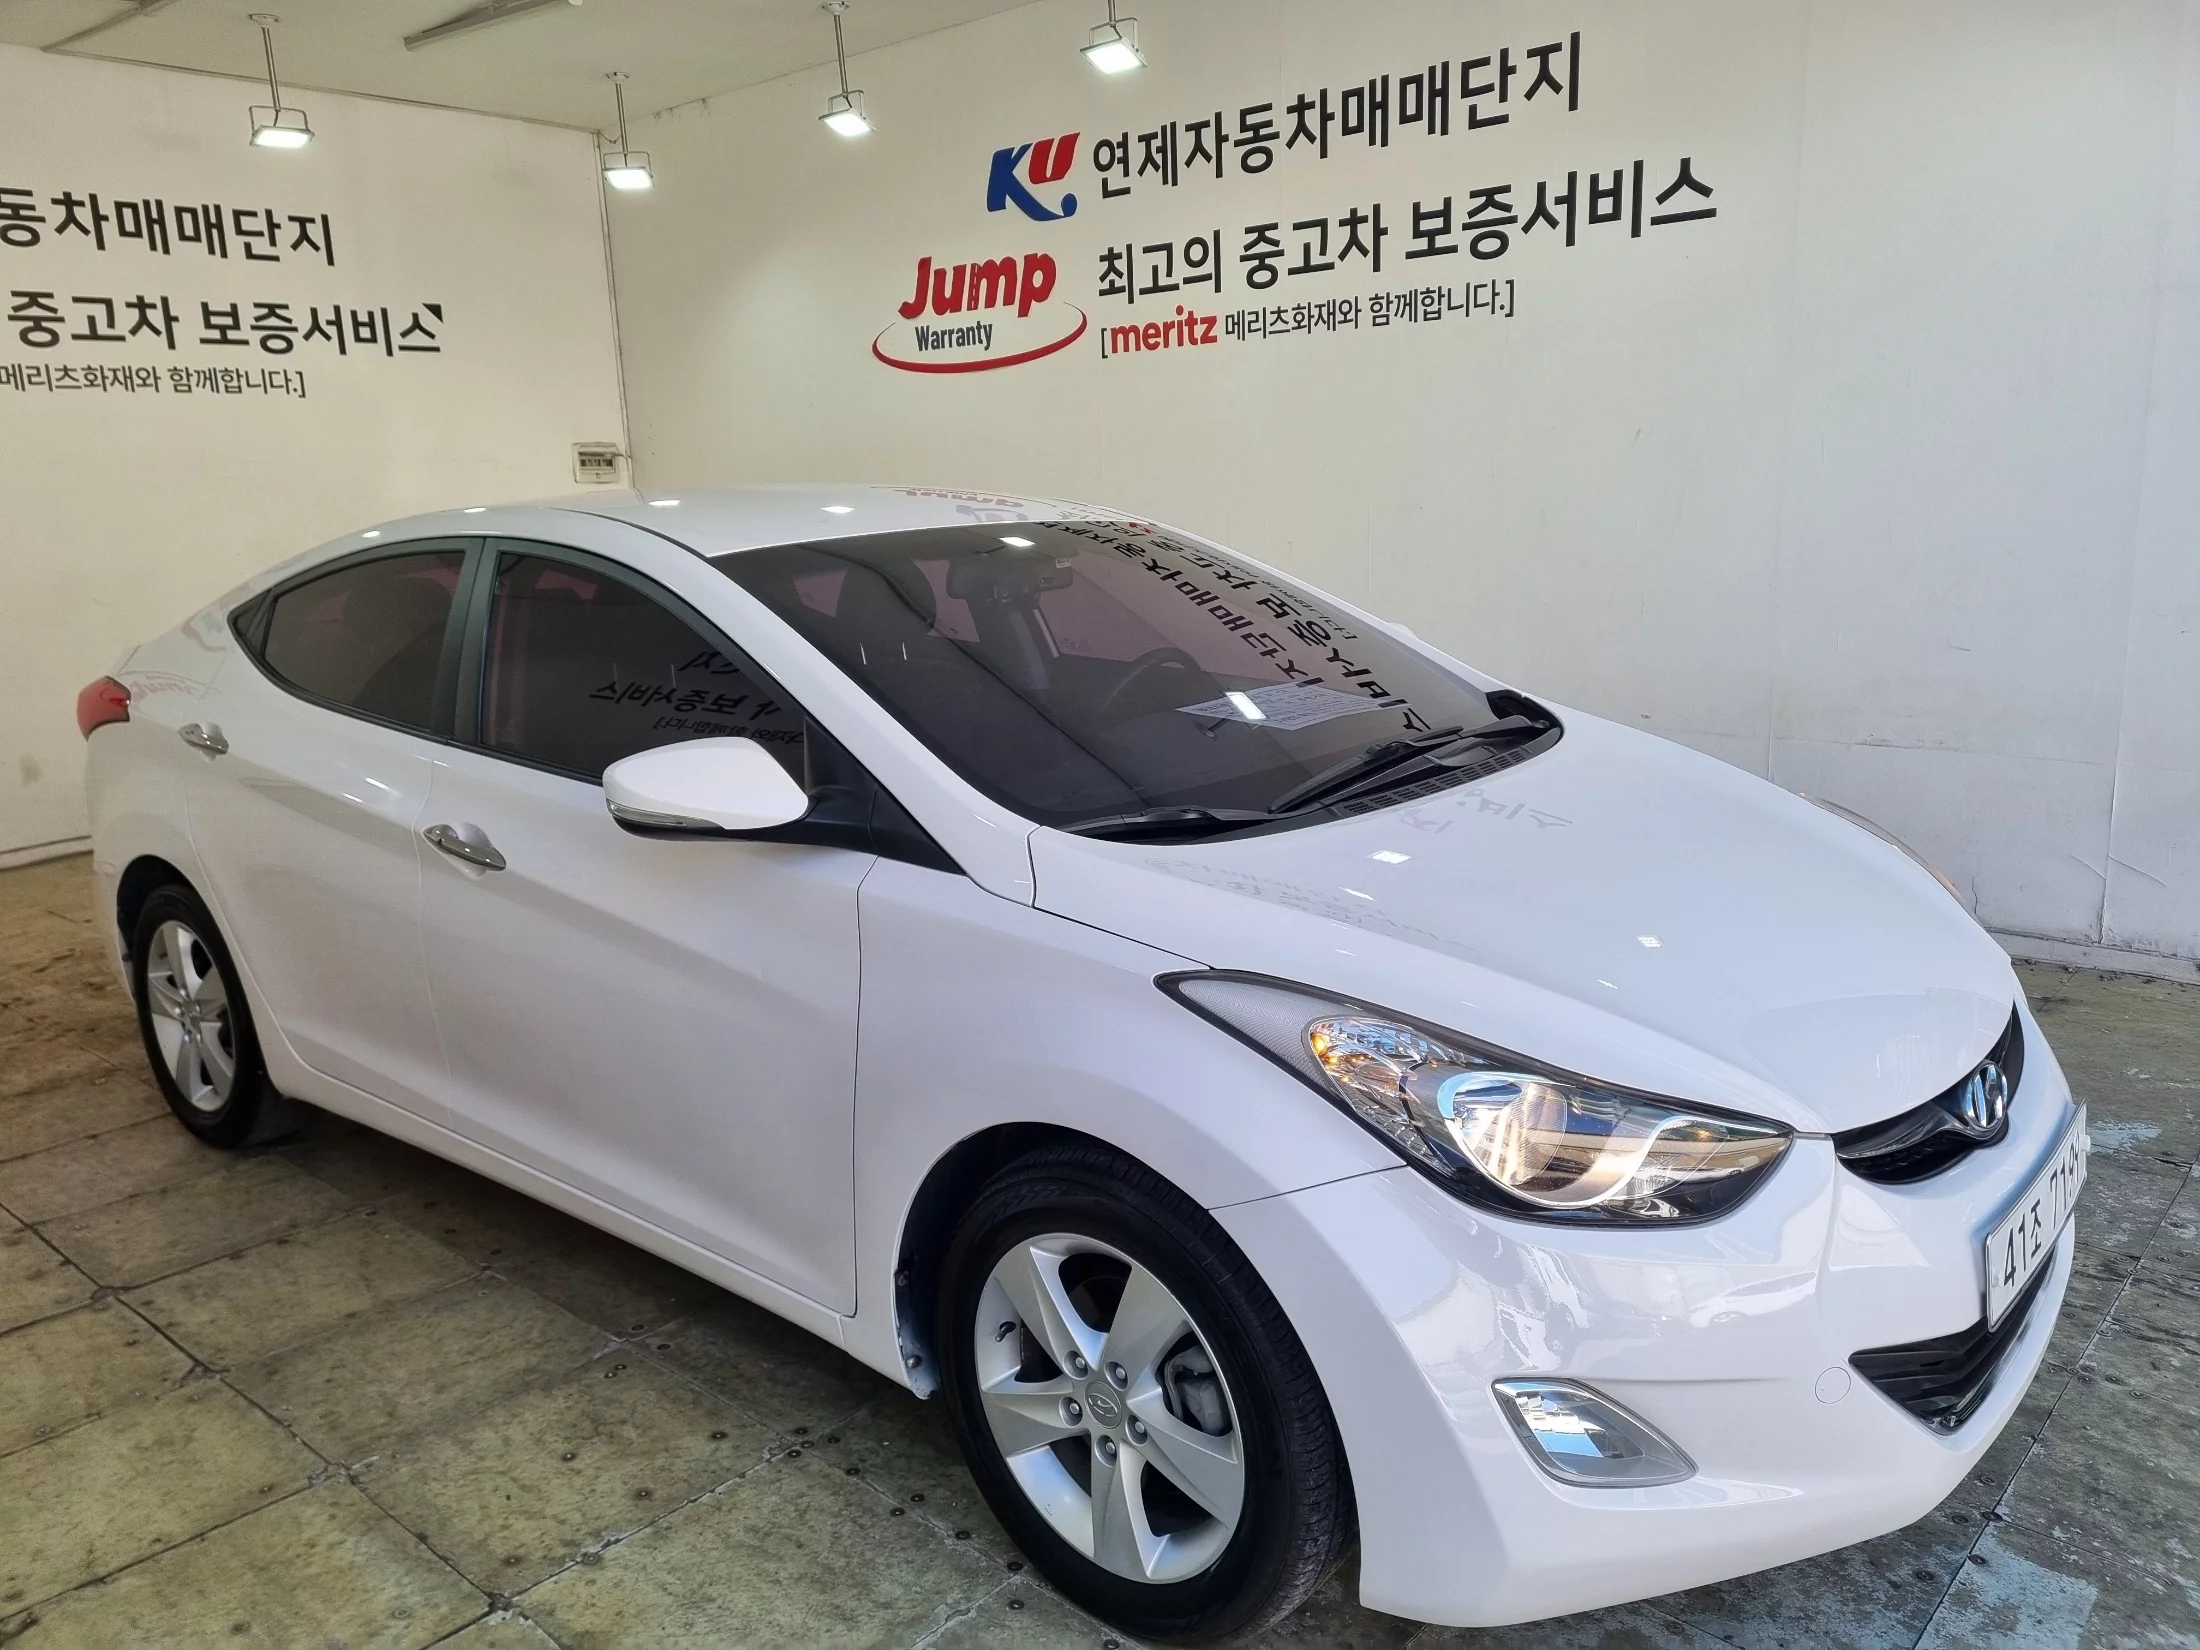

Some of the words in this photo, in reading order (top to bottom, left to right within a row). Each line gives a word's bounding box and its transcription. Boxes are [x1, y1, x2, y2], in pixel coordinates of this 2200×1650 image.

[1093, 31, 1581, 199] 연제자동차매매단지
[1099, 229, 1221, 304] 최고의
[1240, 203, 1388, 289] 중고차
[1405, 157, 1717, 260] 보증서비스
[898, 253, 1057, 319] Jump
[1225, 296, 1362, 341] 메리츠화재와
[1369, 279, 1515, 327] 함께합니다.]
[7, 290, 180, 351] 중고차
[199, 301, 442, 357] 보증서비스
[914, 320, 993, 352] Warranty
[0, 363, 162, 394] 메리츠화재와
[169, 366, 306, 398] 함께합니다.]
[2003, 1199, 2042, 1288] 41조
